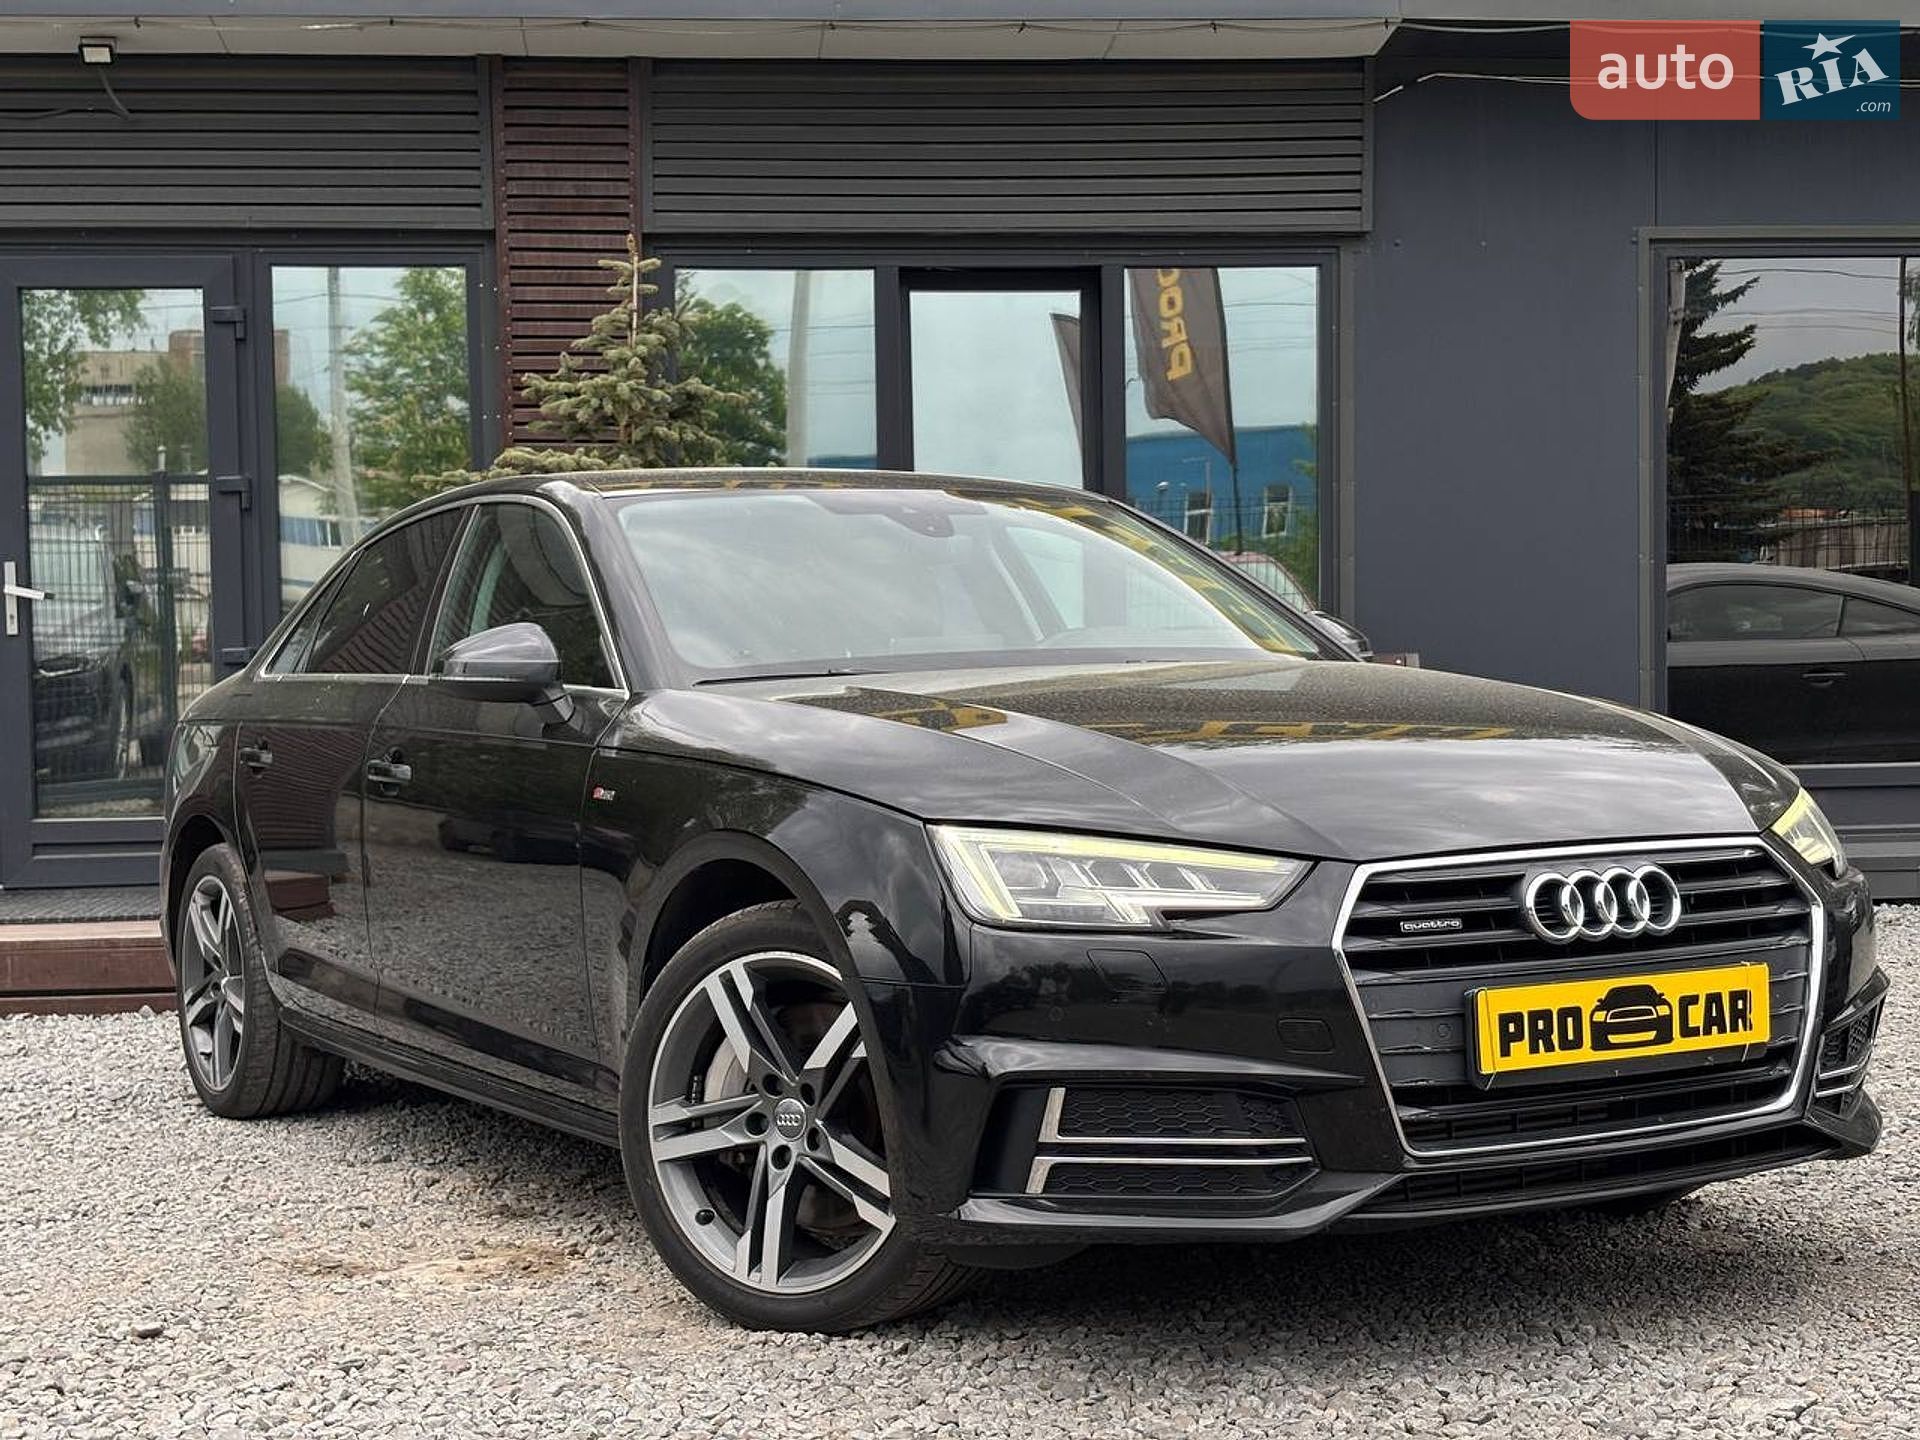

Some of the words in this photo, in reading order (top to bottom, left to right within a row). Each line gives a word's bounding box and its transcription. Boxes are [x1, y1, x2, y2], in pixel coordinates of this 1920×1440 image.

[1403, 919, 1460, 932] quattro
[1498, 1005, 1584, 1058] PRO
[1678, 988, 1754, 1039] CAR
